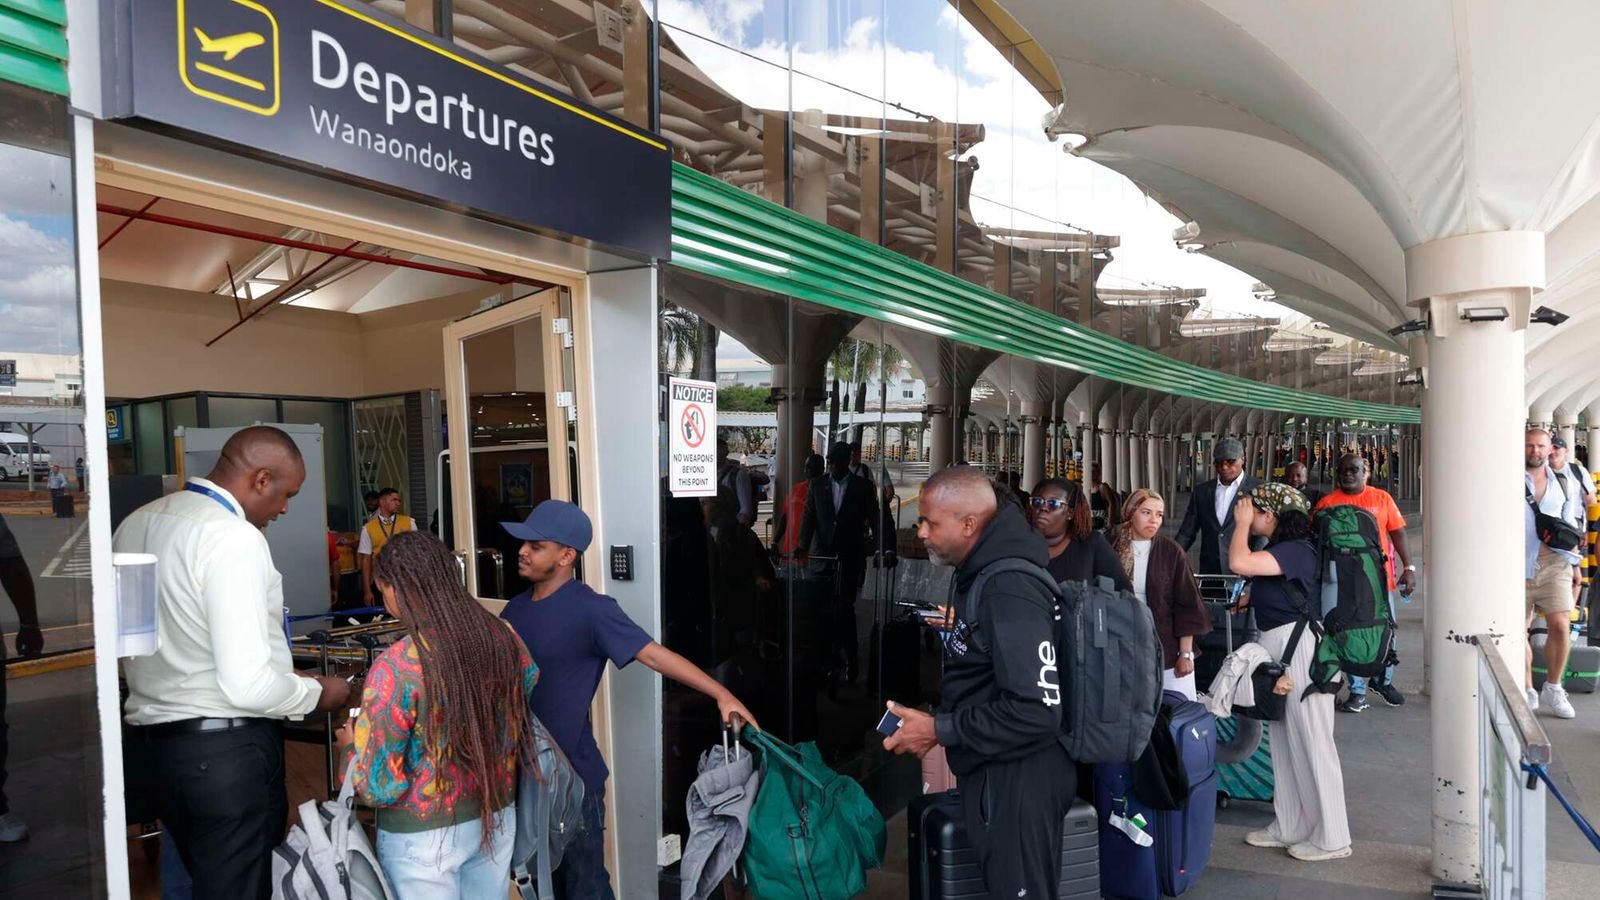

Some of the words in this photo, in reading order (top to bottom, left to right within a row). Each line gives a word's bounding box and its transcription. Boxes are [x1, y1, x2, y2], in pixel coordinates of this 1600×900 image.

[311, 29, 555, 166] Departures
[309, 105, 472, 180] Wanaondoka
[675, 385, 713, 402] NOTICE
[673, 454, 682, 462] NO
[683, 454, 714, 463] WEAPONS
[682, 465, 705, 474] BEYOND
[678, 478, 691, 486] THIS
[692, 478, 708, 486] POINT
[1037, 640, 1061, 707] the
